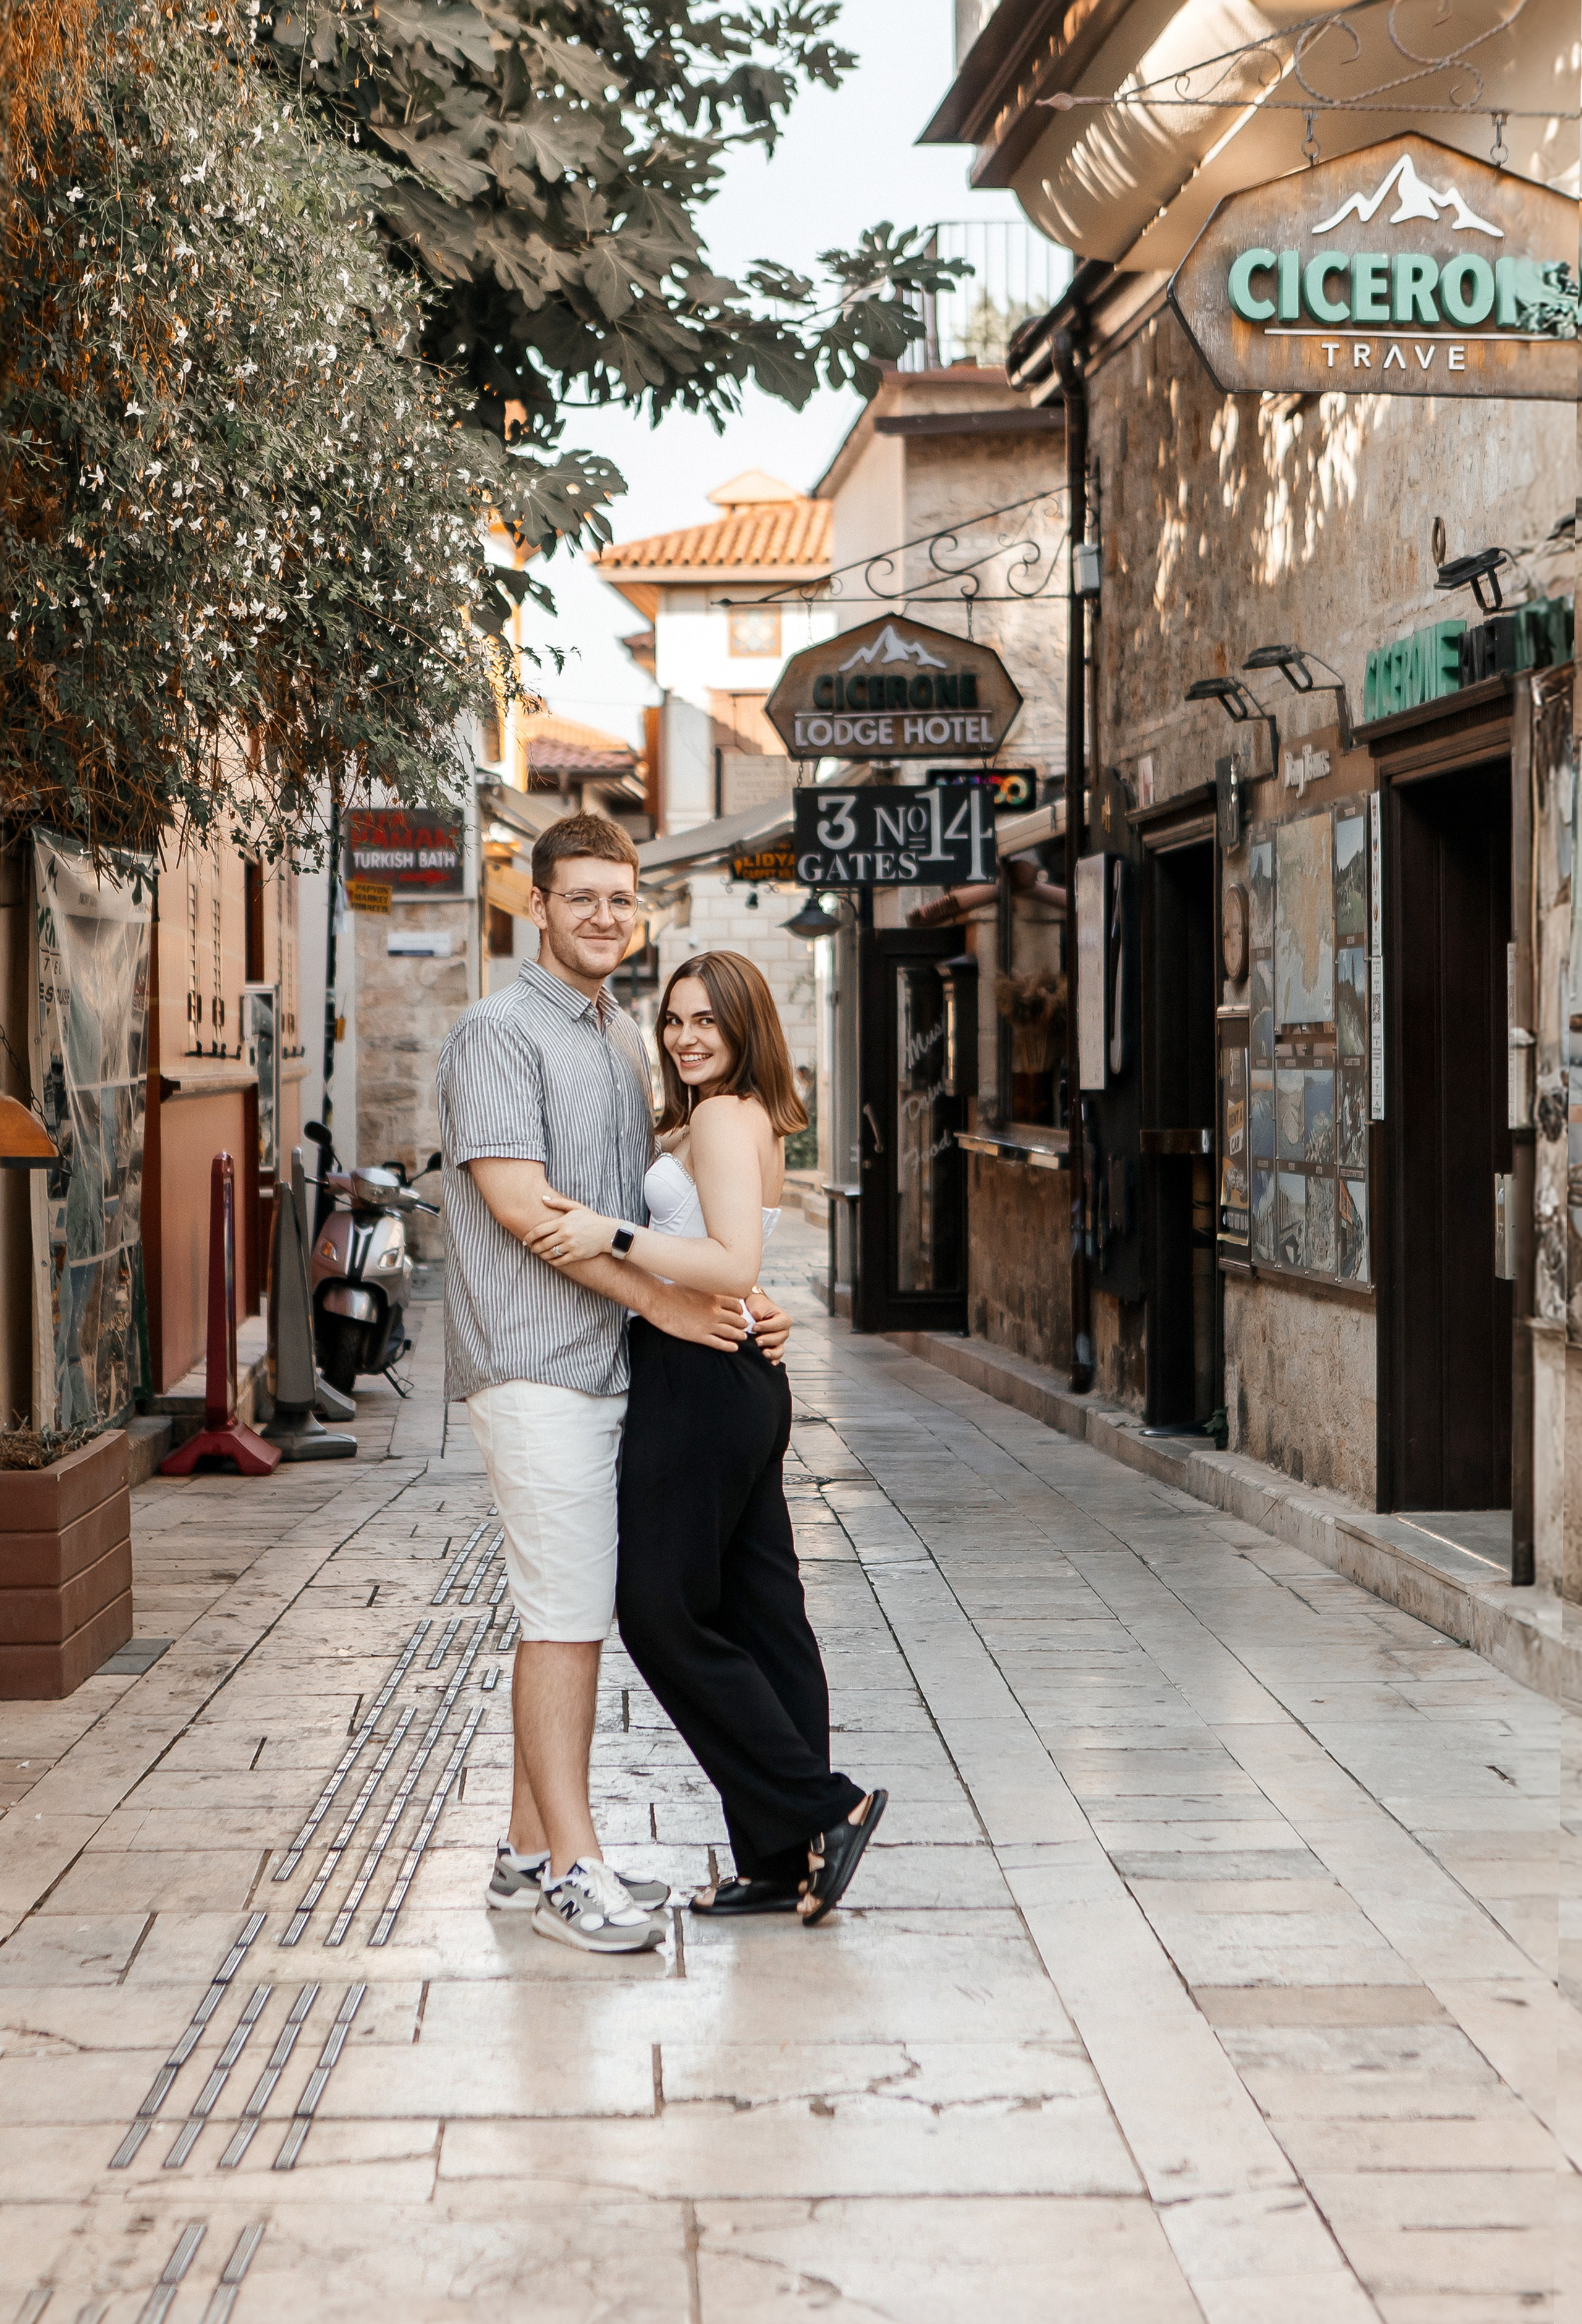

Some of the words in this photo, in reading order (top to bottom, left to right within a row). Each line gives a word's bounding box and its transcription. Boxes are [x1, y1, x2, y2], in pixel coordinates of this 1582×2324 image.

[813, 674, 978, 709] CICERONE
[795, 719, 894, 746] LODGE
[904, 717, 994, 745] HOTEL
[817, 795, 857, 850] 3
[353, 851, 414, 869] TURKISH
[418, 850, 456, 868] BATH
[797, 853, 919, 881] GATES
